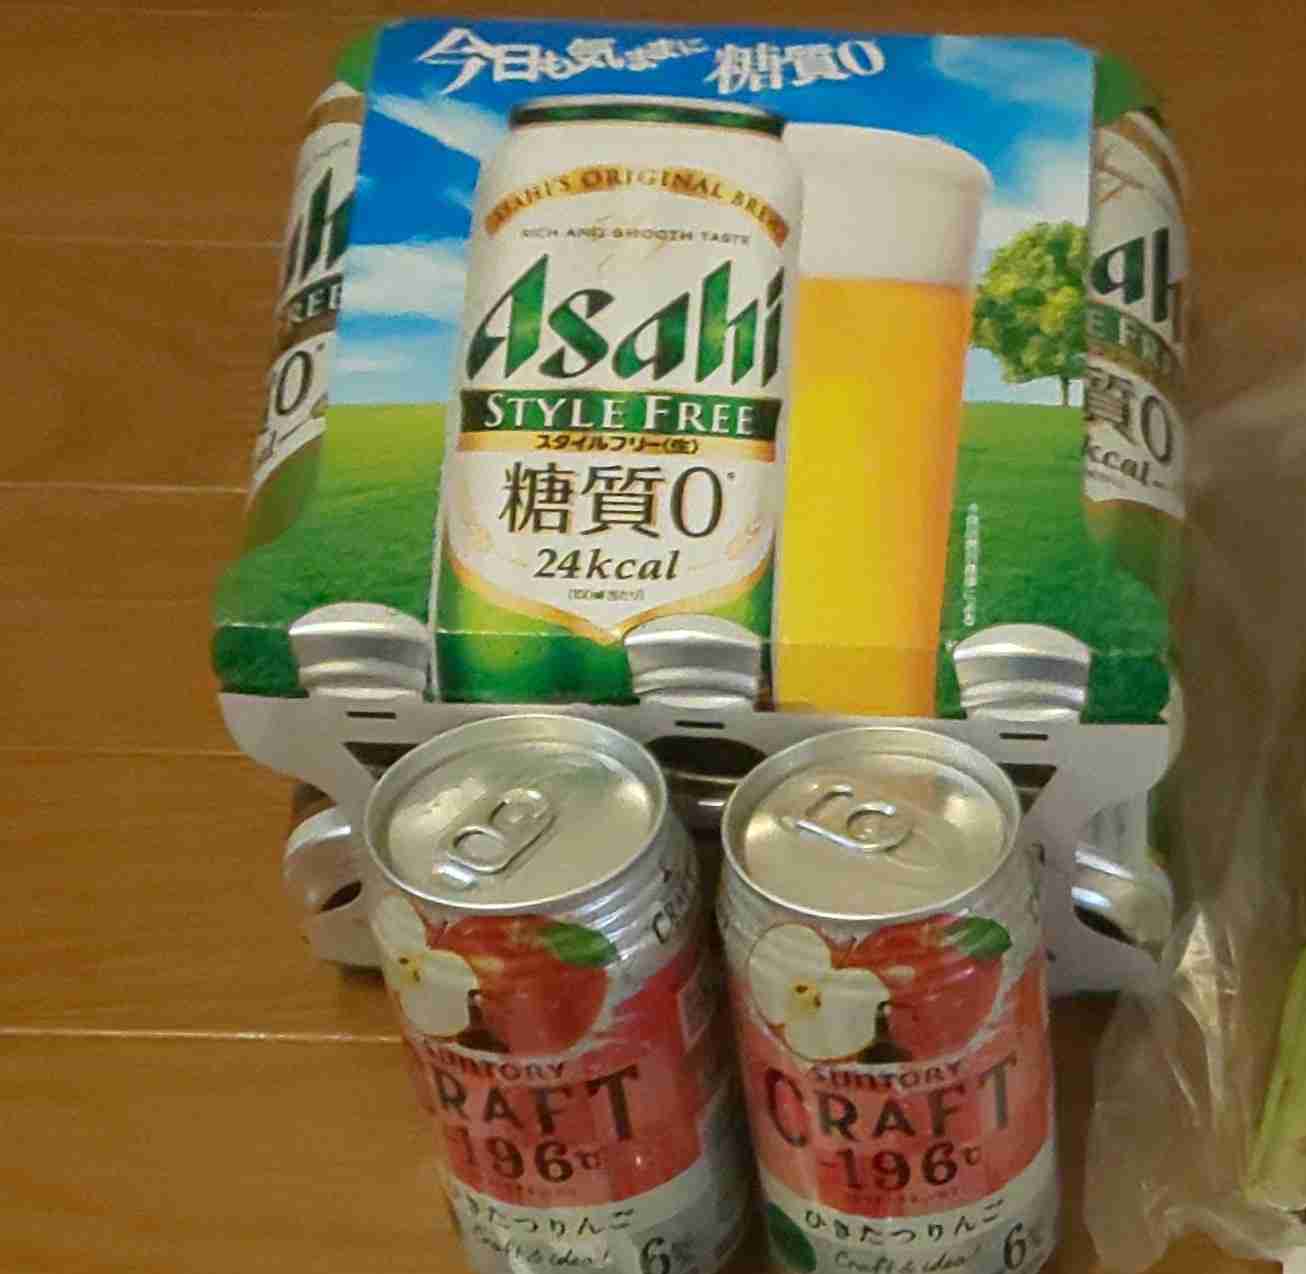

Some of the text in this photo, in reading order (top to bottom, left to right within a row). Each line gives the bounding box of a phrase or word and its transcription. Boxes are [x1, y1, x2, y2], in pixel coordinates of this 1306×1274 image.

[580, 166, 725, 199] ORIGINAL
[465, 253, 786, 388] Asahi
[483, 391, 754, 436] STYLE FREE
[532, 548, 681, 581] 24kcal
[764, 1051, 1019, 1147] CRAFT
